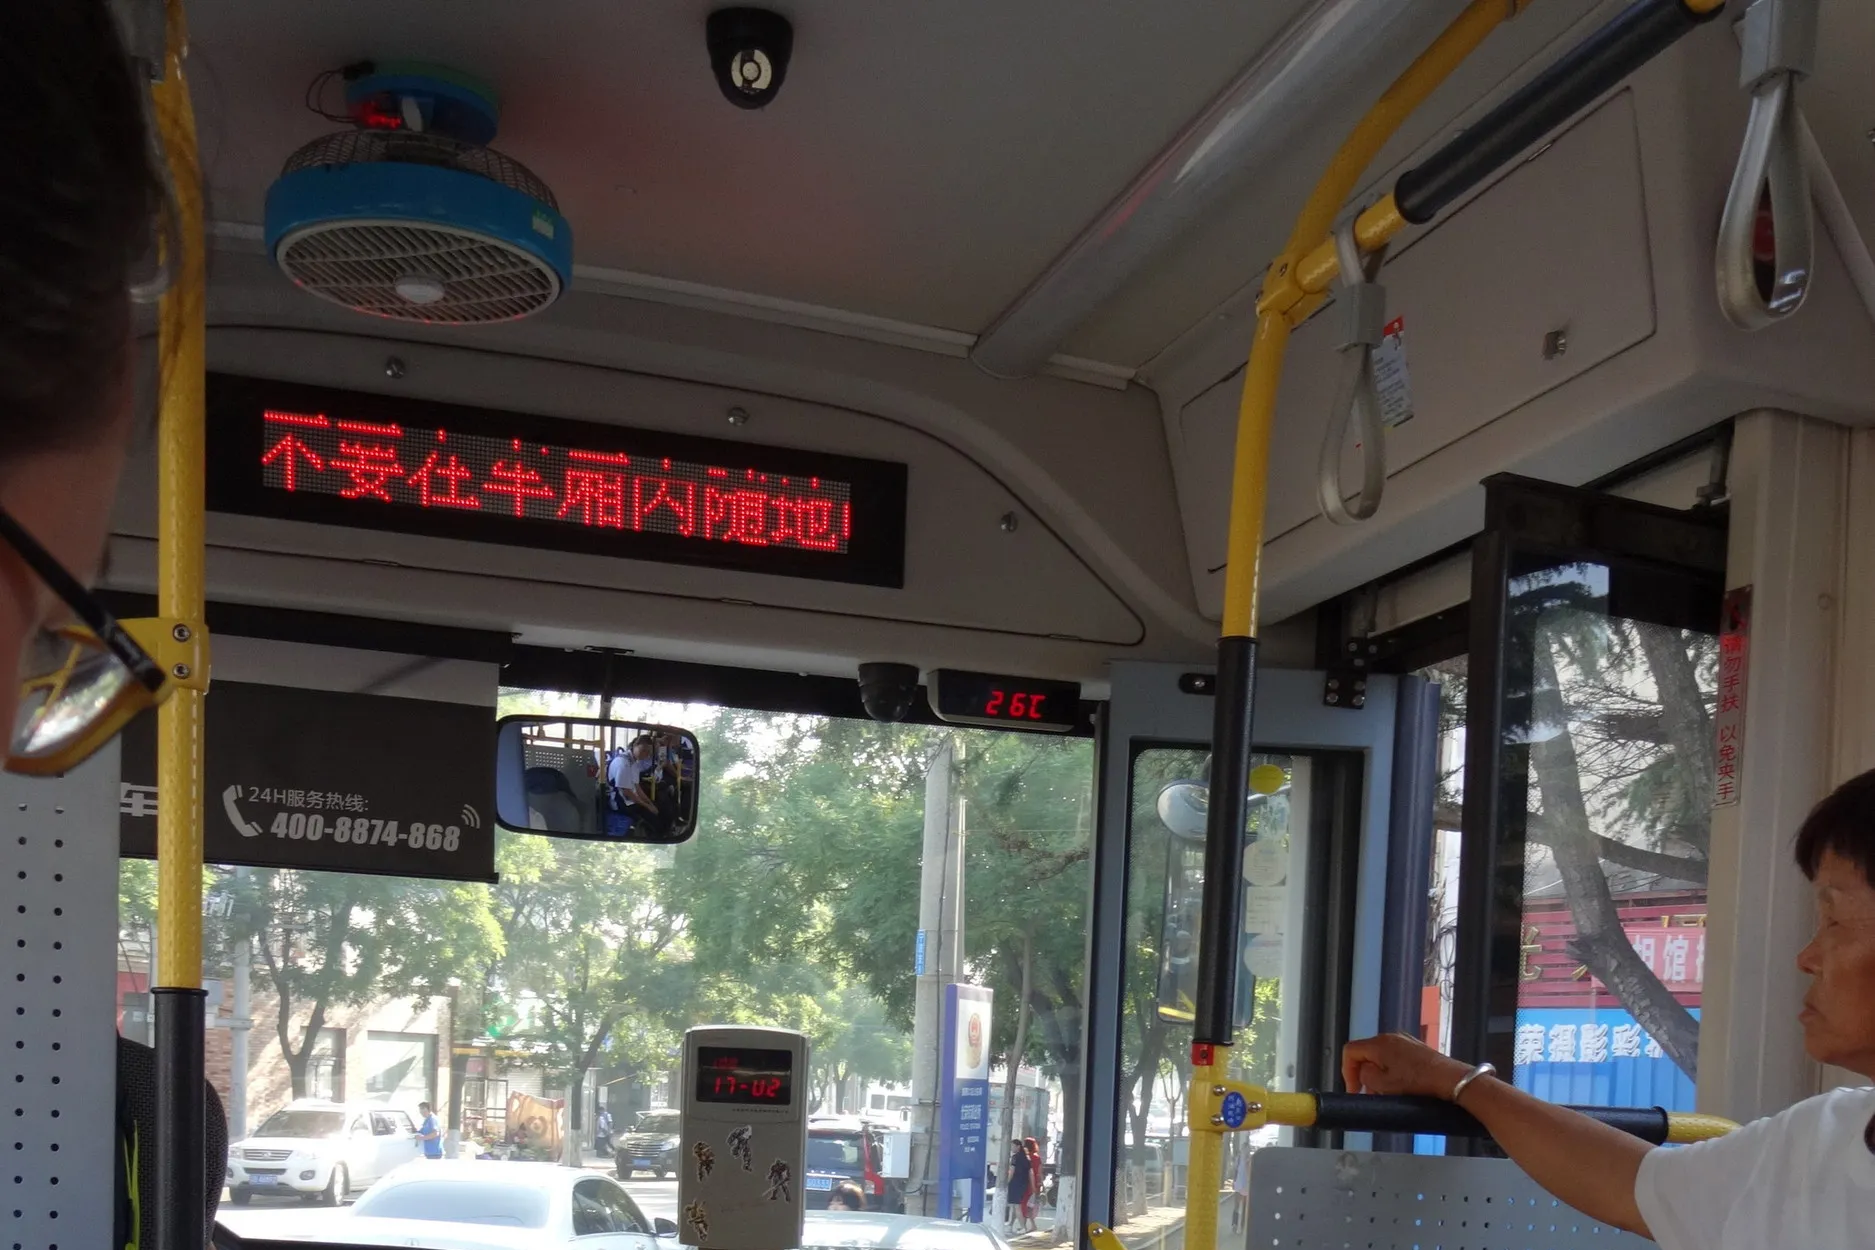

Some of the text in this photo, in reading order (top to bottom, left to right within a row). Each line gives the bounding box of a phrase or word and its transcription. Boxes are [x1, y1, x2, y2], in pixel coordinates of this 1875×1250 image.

[262, 409, 851, 550] 不要在车厢内随地
[1716, 635, 1742, 800] 请勿手扶 以免夹手
[270, 812, 461, 852] 400-8874-868
